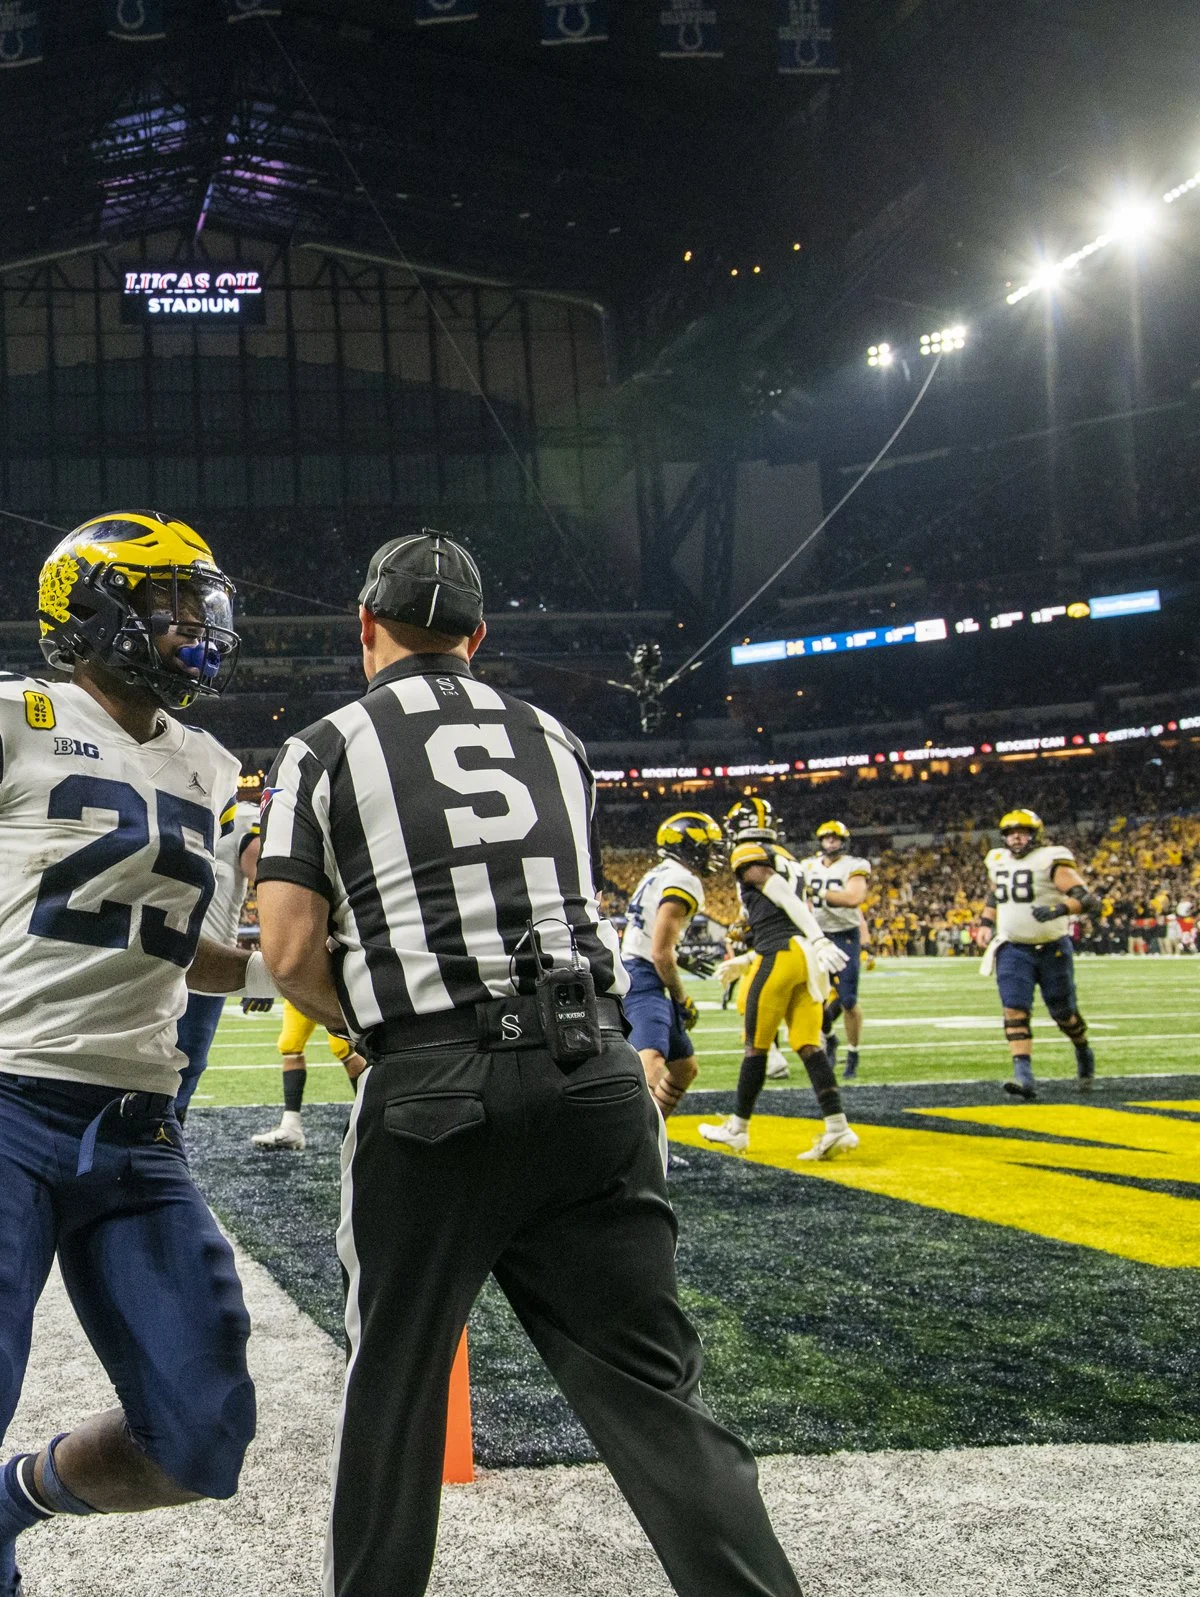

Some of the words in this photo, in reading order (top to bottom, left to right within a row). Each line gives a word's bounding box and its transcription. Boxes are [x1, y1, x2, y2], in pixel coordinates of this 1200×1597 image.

[124, 273, 210, 294] LUCAS
[215, 272, 262, 294] OIL
[148, 298, 240, 313] STADIUM
[34, 703, 47, 714] 42
[424, 723, 538, 849] S
[27, 774, 218, 966] 25
